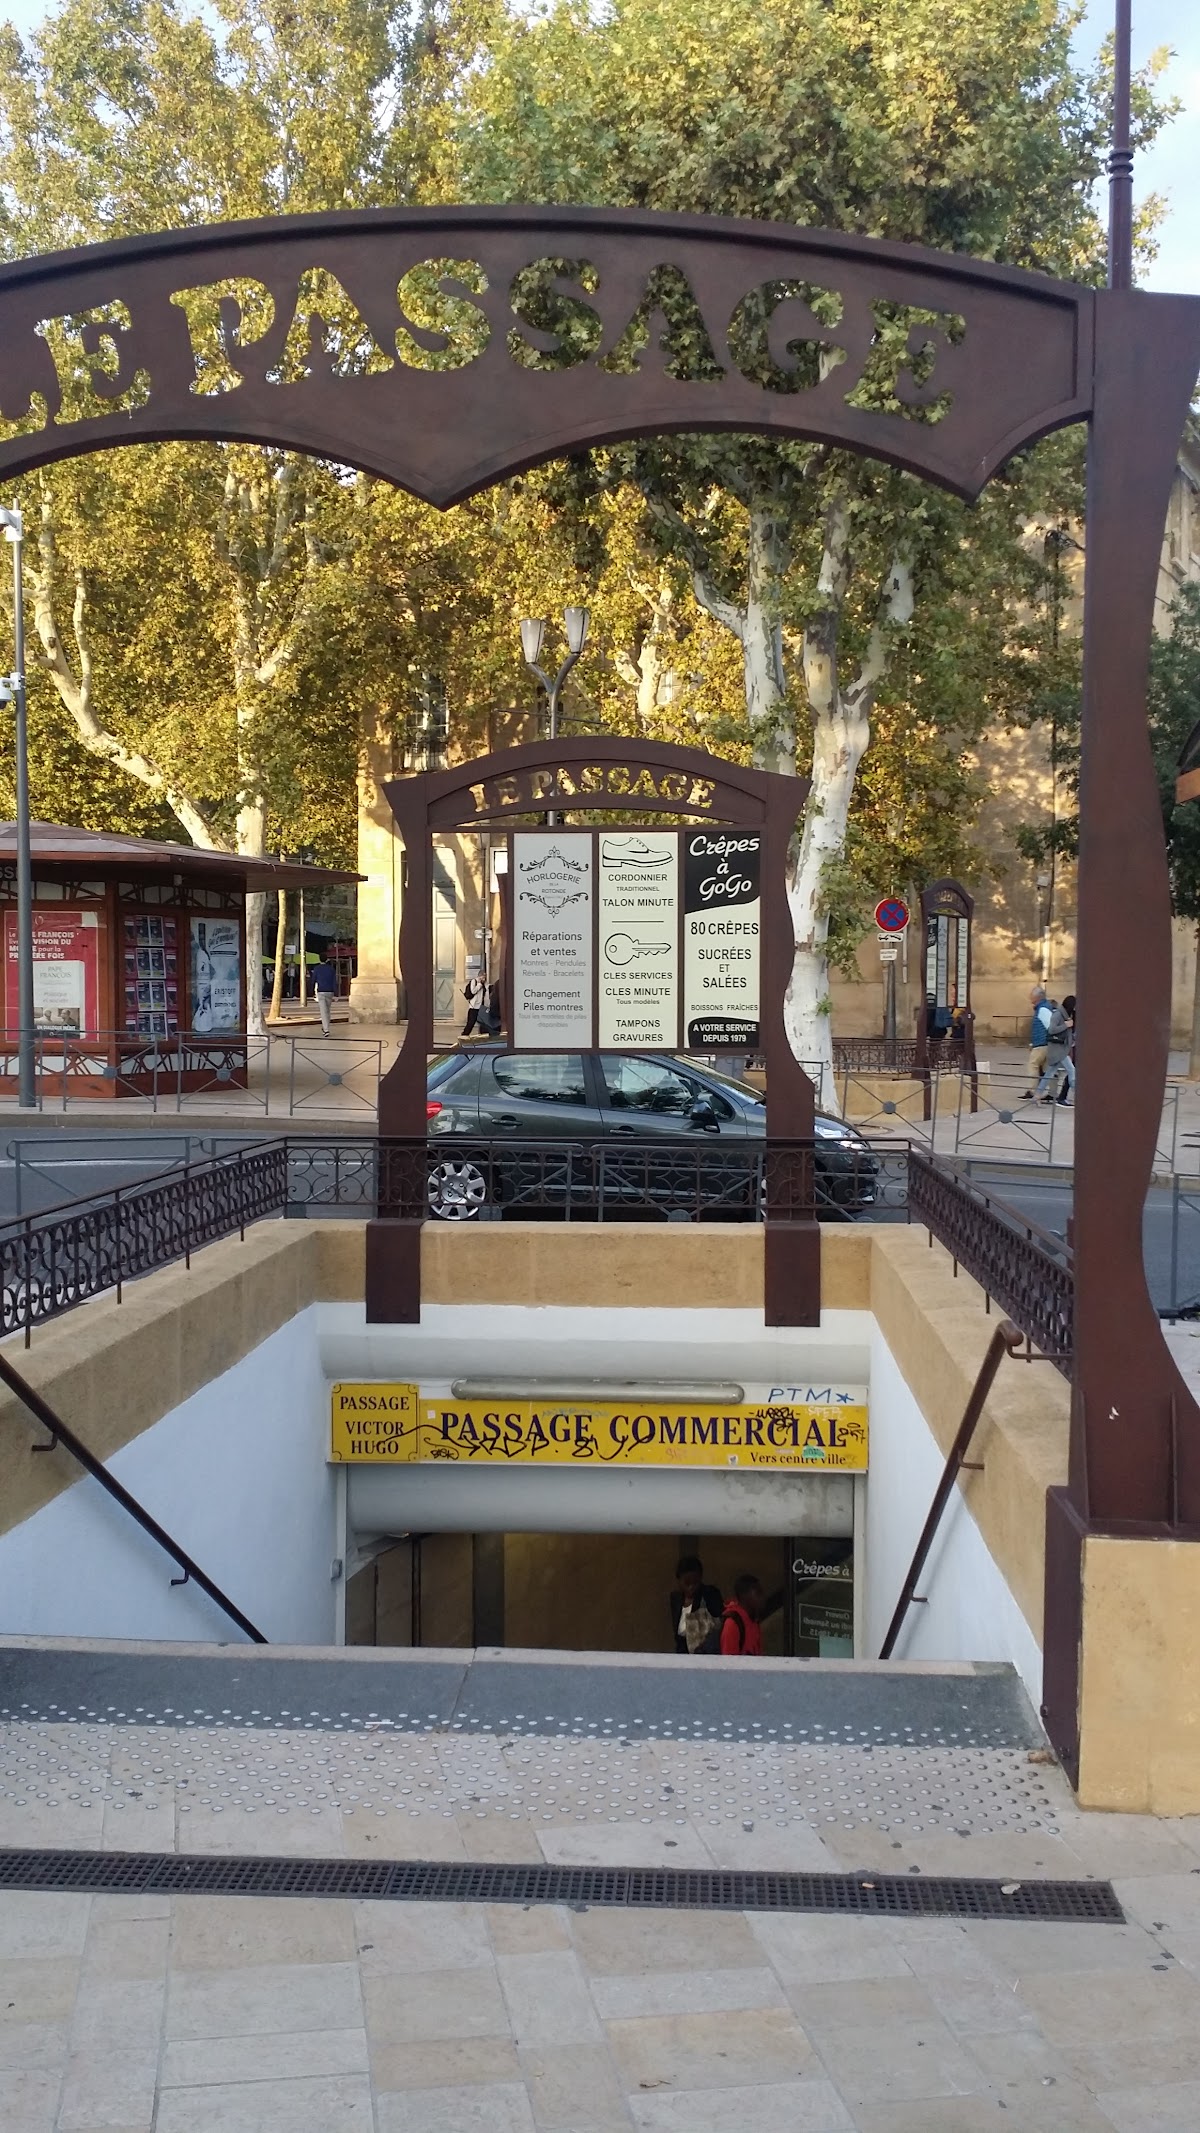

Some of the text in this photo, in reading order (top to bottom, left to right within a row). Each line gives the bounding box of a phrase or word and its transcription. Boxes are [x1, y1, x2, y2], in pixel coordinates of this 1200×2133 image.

[0, 257, 967, 440] E PASSAGE
[528, 766, 717, 809] PASSAGE
[689, 835, 760, 857] Crêpes
[717, 858, 729, 874] à
[527, 872, 581, 884] HORLOGERIE
[699, 874, 752, 901] GoGo
[691, 920, 759, 935] 80 CRÊPES
[522, 931, 583, 943] Réparations
[530, 948, 577, 956] et ventes
[698, 946, 752, 960] SUCRÉES
[719, 964, 730, 972] ET
[702, 974, 747, 988] SALÉES
[523, 989, 581, 1000] Changement
[523, 1002, 584, 1011] Piles montres
[727, 1003, 758, 1011] FRAÎCHES
[693, 1024, 757, 1032] A VOTRE SERVICE
[703, 1034, 747, 1042] DEPUIS 1979
[768, 1388, 831, 1402] PTM
[340, 1396, 410, 1410] PASSAGE
[346, 1421, 405, 1435] VICTOR
[441, 1412, 594, 1442] PASSAGE
[609, 1415, 847, 1447] COMMERCIAL
[351, 1440, 399, 1454] HUGO
[751, 1452, 777, 1463] Vers
[779, 1454, 818, 1463] centre
[820, 1452, 846, 1465] ville
[792, 1559, 850, 1577] Crêpes à
